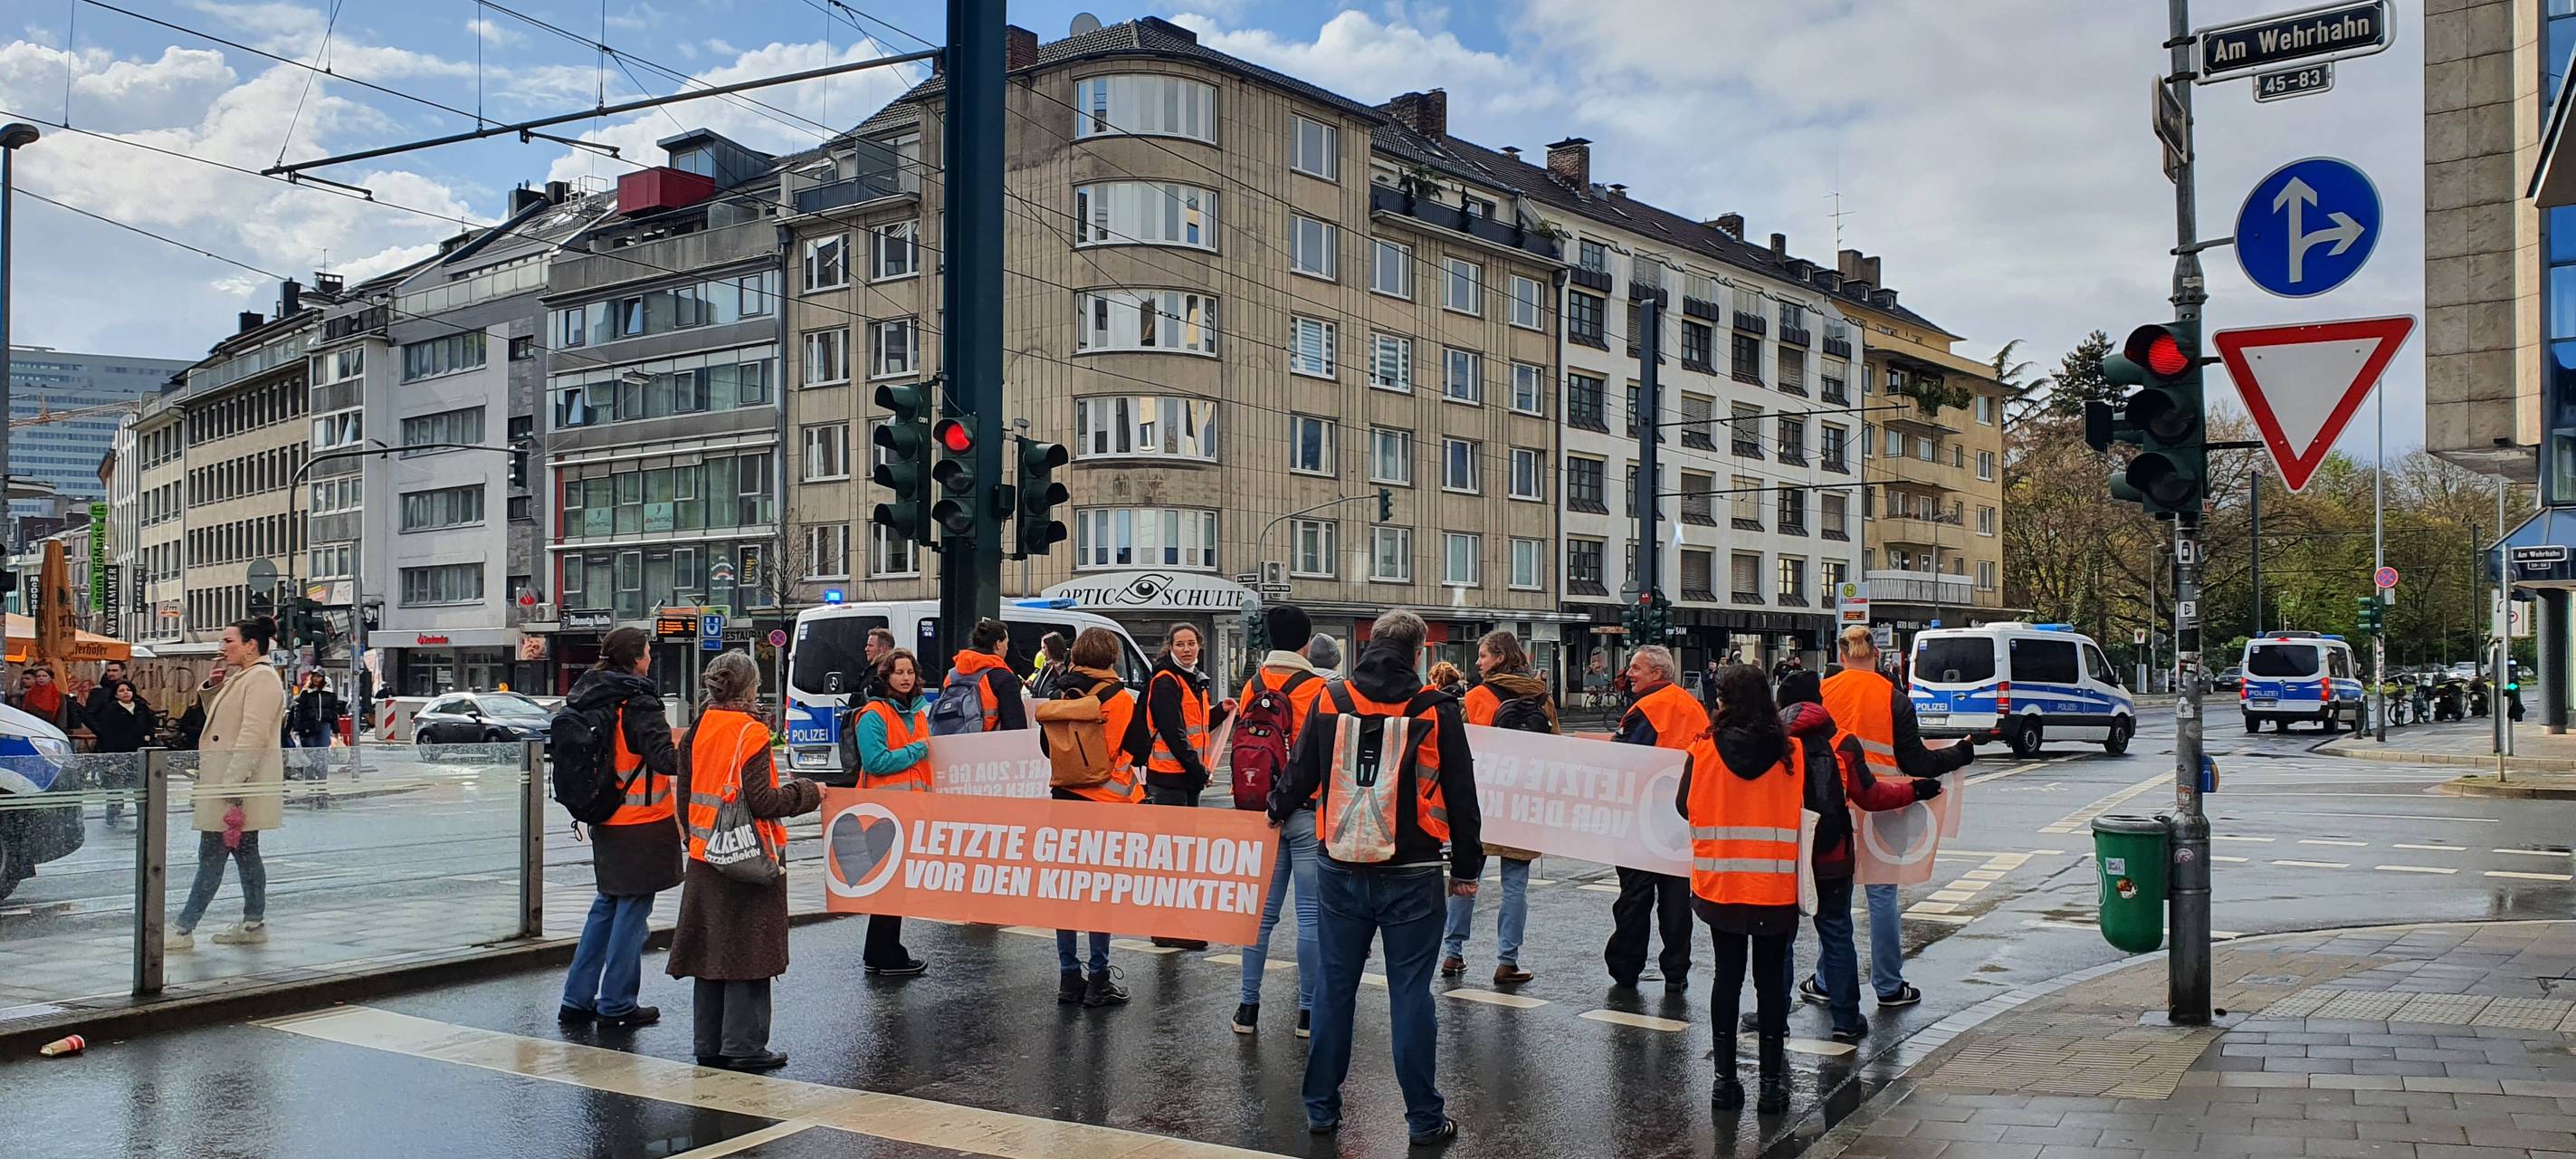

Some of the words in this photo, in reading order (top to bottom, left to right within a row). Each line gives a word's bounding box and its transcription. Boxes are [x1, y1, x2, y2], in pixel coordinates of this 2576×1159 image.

[2214, 39, 2247, 63] Am
[2258, 14, 2370, 54] Wehrhahn
[2265, 69, 2321, 93] 45-83
[2529, 550, 2561, 558] Wehrhahn
[107, 568, 118, 635] WARHAMMER
[164, 602, 177, 610] dm
[1059, 588, 1116, 606] OPTIC
[1162, 589, 1245, 607] SCHULTE
[570, 616, 594, 627] Beauty
[706, 617, 719, 635] U
[1916, 703, 1948, 711] POLIZEI
[2057, 703, 2076, 711] POLIZEI
[792, 728, 828, 742] POLIZEI
[909, 819, 1026, 860] LETZTE
[1033, 827, 1263, 876] GENERATION
[904, 858, 966, 892] VOR
[971, 864, 1031, 896] DEN
[1037, 867, 1259, 915] KIPPPUNKTEN
